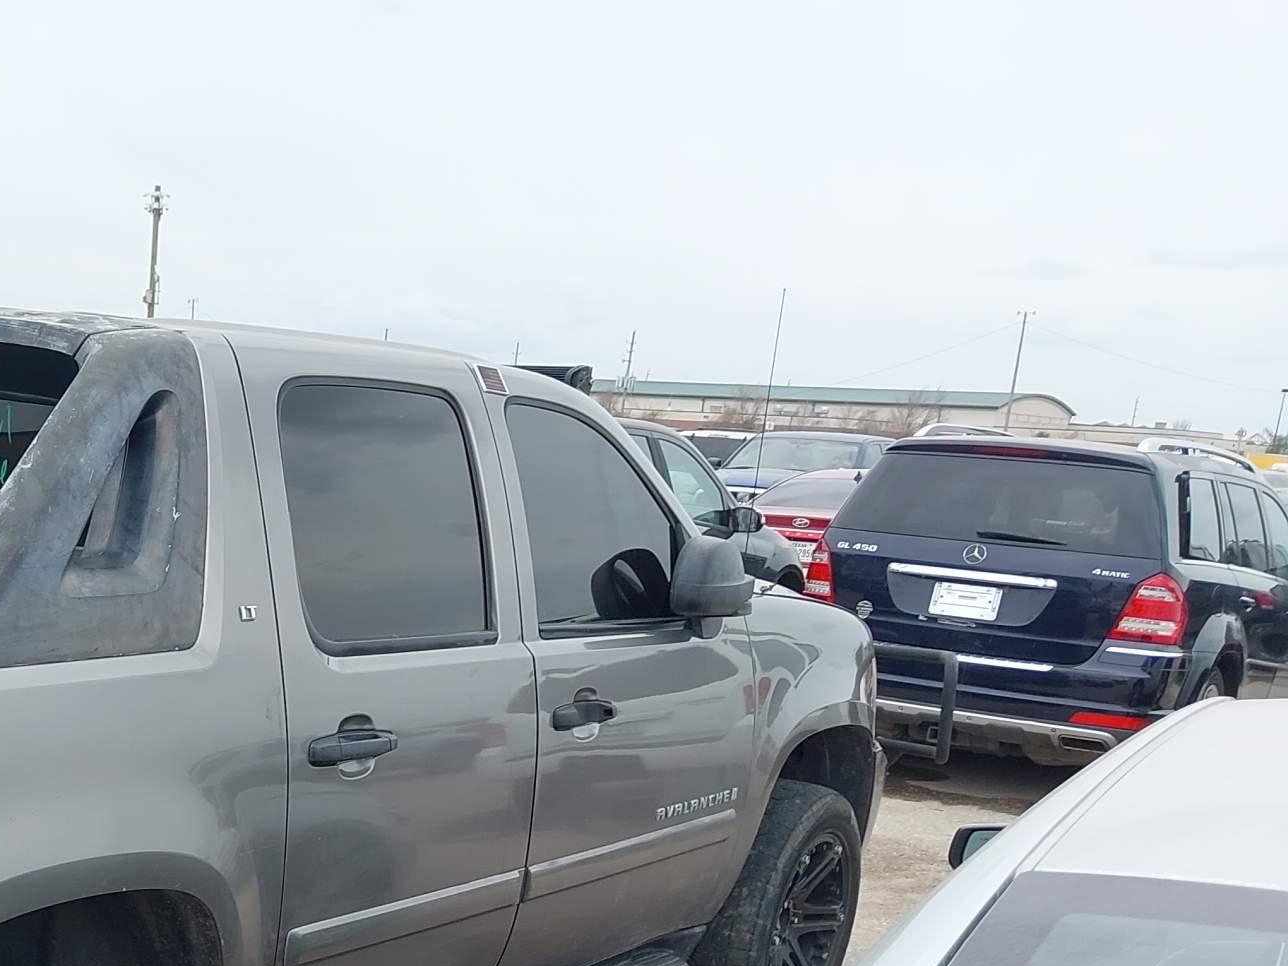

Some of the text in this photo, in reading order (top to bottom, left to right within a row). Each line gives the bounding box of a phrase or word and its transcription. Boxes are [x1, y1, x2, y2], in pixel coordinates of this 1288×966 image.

[837, 541, 878, 552] GL 450
[656, 789, 731, 820] AVALANCHE
